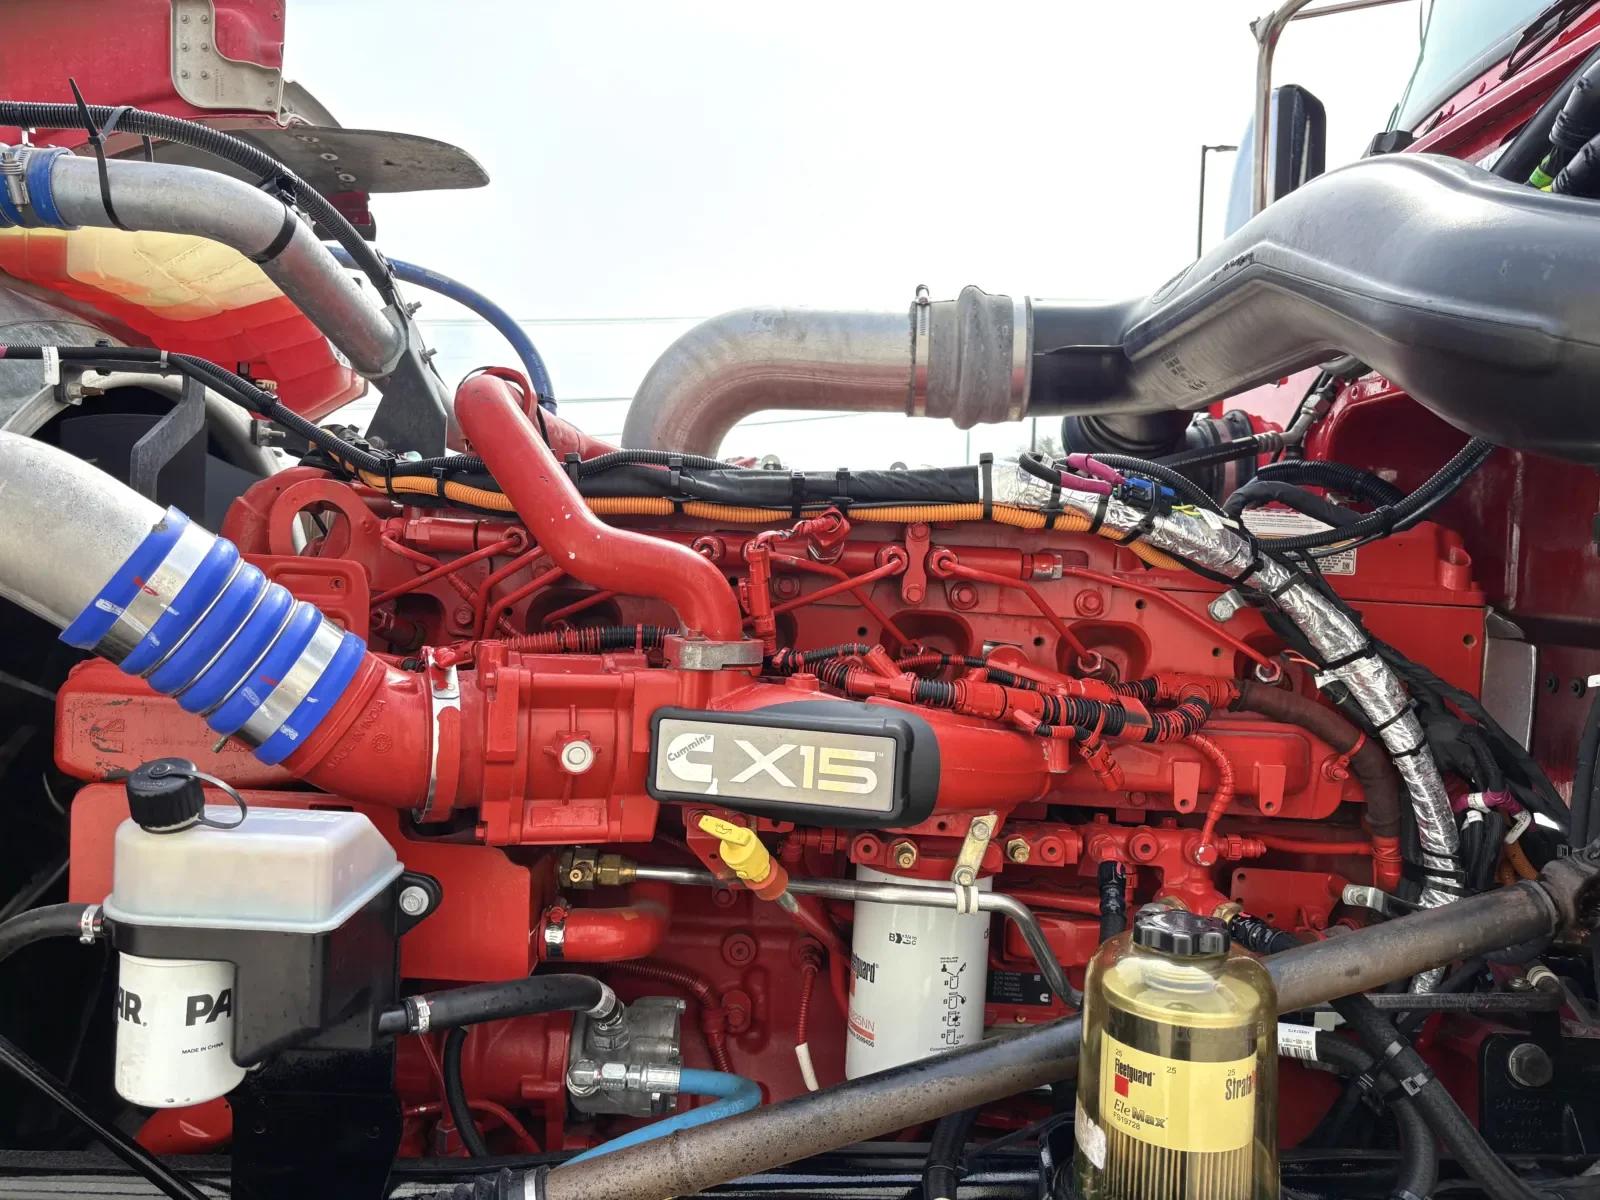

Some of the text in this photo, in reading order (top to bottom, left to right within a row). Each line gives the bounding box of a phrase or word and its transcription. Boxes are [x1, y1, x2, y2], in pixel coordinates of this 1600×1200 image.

[667, 733, 712, 762] Cummins
[181, 1047, 199, 1055] MADE
[207, 1042, 224, 1050] CHINA
[1166, 1066, 1177, 1074] 25
[1227, 1068, 1236, 1077] 25
